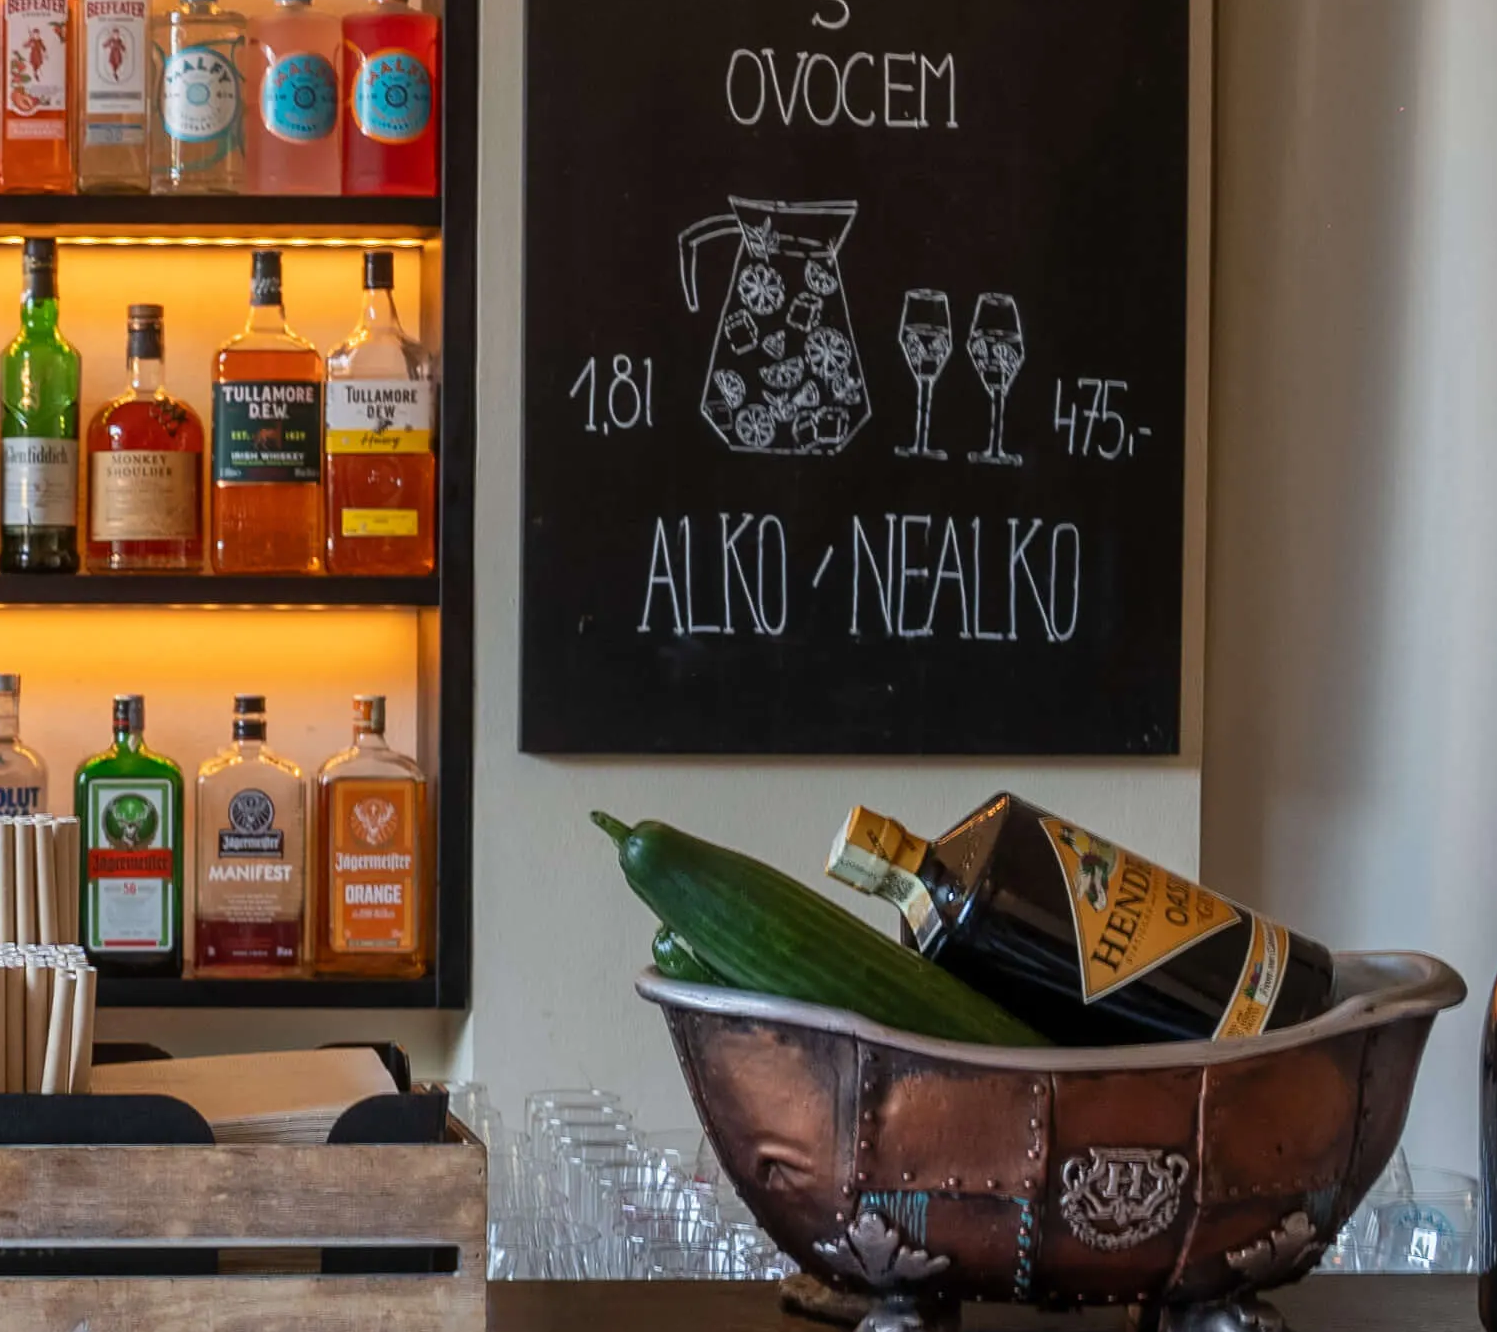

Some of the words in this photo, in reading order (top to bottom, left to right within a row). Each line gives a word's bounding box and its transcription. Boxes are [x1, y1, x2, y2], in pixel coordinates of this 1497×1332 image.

[87, 0, 145, 18] BEEFEATER
[725, 49, 958, 128] OVOCEM
[222, 385, 314, 403] TULLAMORE
[345, 385, 418, 404] TULLAMORE
[366, 405, 395, 419] DEW
[111, 454, 167, 466] MONKEY
[231, 452, 258, 461] IRISH
[260, 452, 304, 461] WHISKEY
[637, 513, 787, 635] ALKO
[850, 513, 1081, 641] NEALKO
[208, 864, 293, 882] MANIFEST
[345, 884, 402, 905] ORANGE
